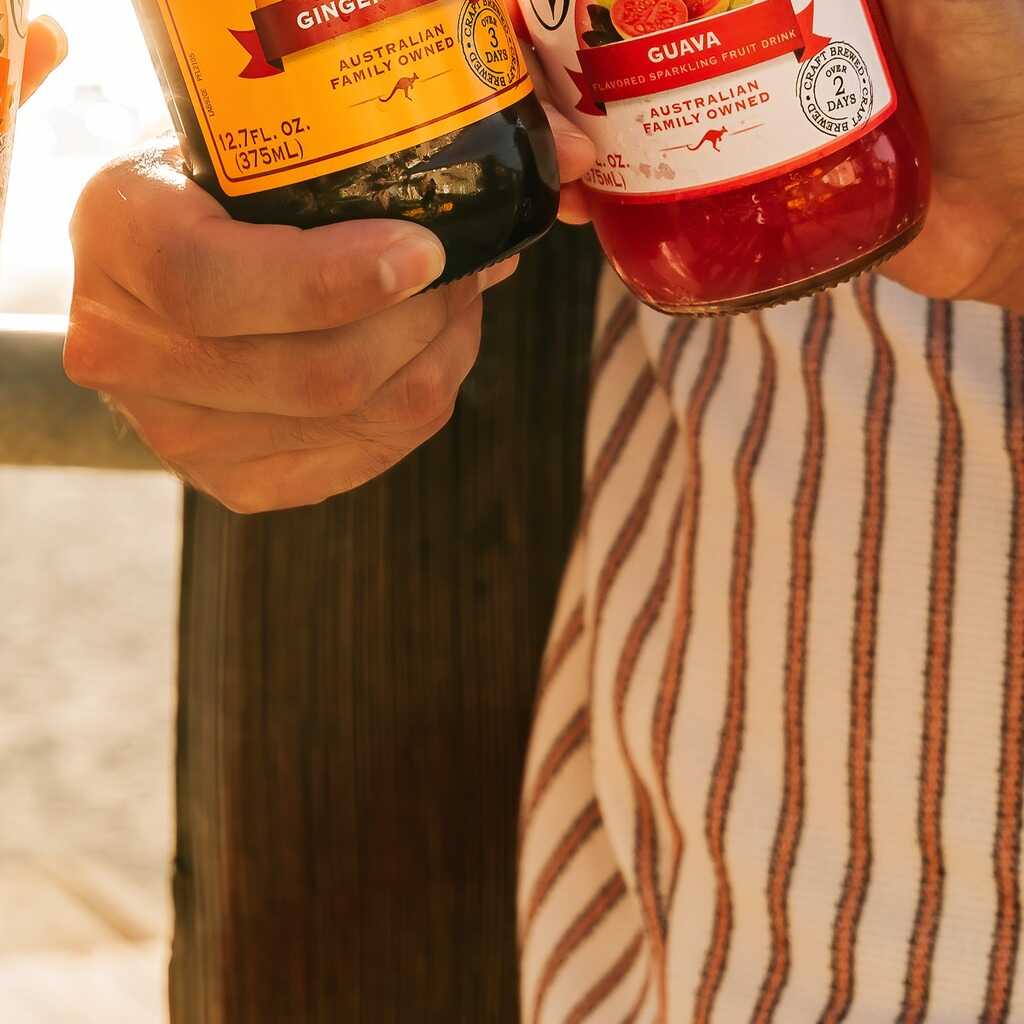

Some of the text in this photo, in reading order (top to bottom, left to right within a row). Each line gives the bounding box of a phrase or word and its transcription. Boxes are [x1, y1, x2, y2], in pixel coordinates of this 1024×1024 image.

[339, 23, 445, 72] AUSTRALIAN
[488, 27, 499, 48] 3
[647, 31, 721, 64] GUAVA
[330, 36, 454, 90] FAMILY OWNED
[485, 49, 508, 63] DAYS
[592, 29, 797, 92] FLAVORED SPARKLING FRUIT DRINK
[804, 46, 864, 90] CRAFT BREWED
[825, 65, 847, 77] OVER
[649, 79, 759, 118] AUSTRALIAN
[833, 75, 845, 96] 2
[643, 91, 770, 135] FAMILY OWNED
[807, 103, 849, 132] BREWED
[827, 93, 857, 112] DAYS
[219, 117, 311, 151] 12.7FL. OZ.
[236, 139, 304, 173] (375ML)
[607, 154, 630, 168] OZ.
